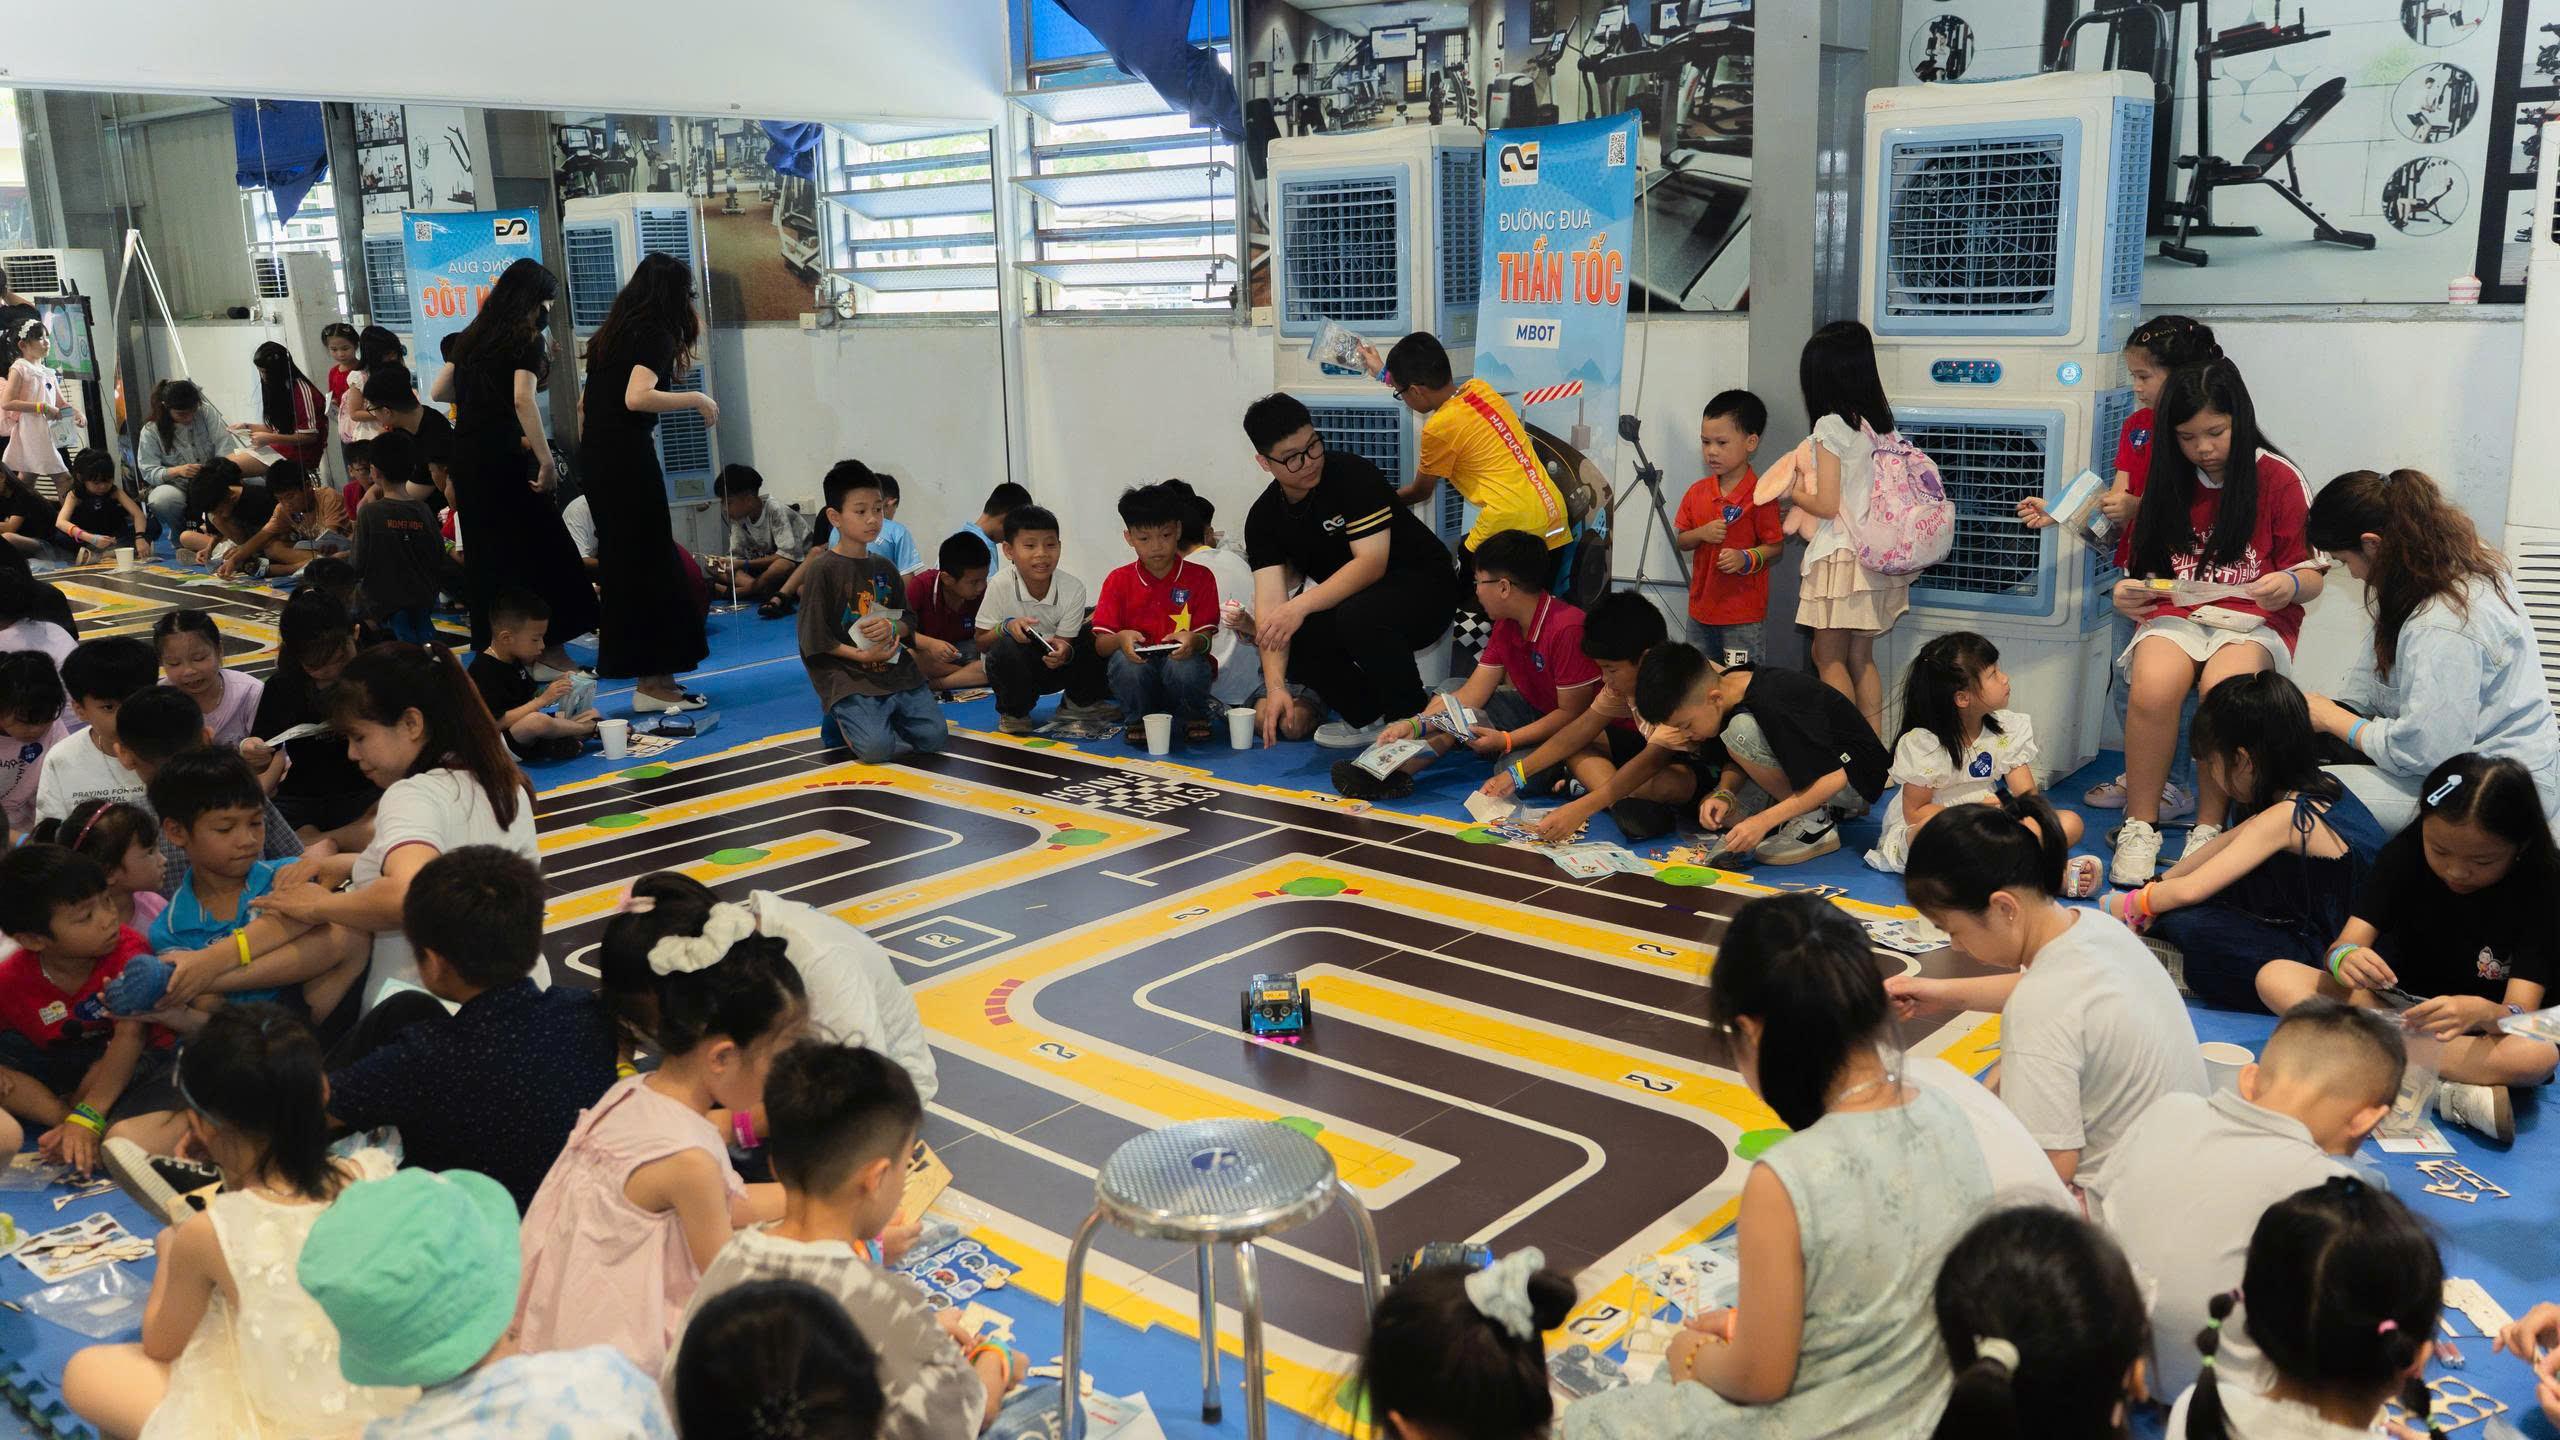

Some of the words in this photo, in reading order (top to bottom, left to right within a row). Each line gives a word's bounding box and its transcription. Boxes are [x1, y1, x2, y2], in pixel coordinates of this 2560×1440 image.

[1499, 209, 1555, 232] ĐƯỜNG
[1560, 209, 1592, 230] ĐUA
[1498, 234, 1563, 304] THẦN
[1572, 232, 1622, 305] TỐC
[1516, 324, 1555, 341] MBOT
[72, 789, 109, 798] PRAYING
[1042, 771, 1149, 801] FINISH
[1124, 788, 1220, 817] START
